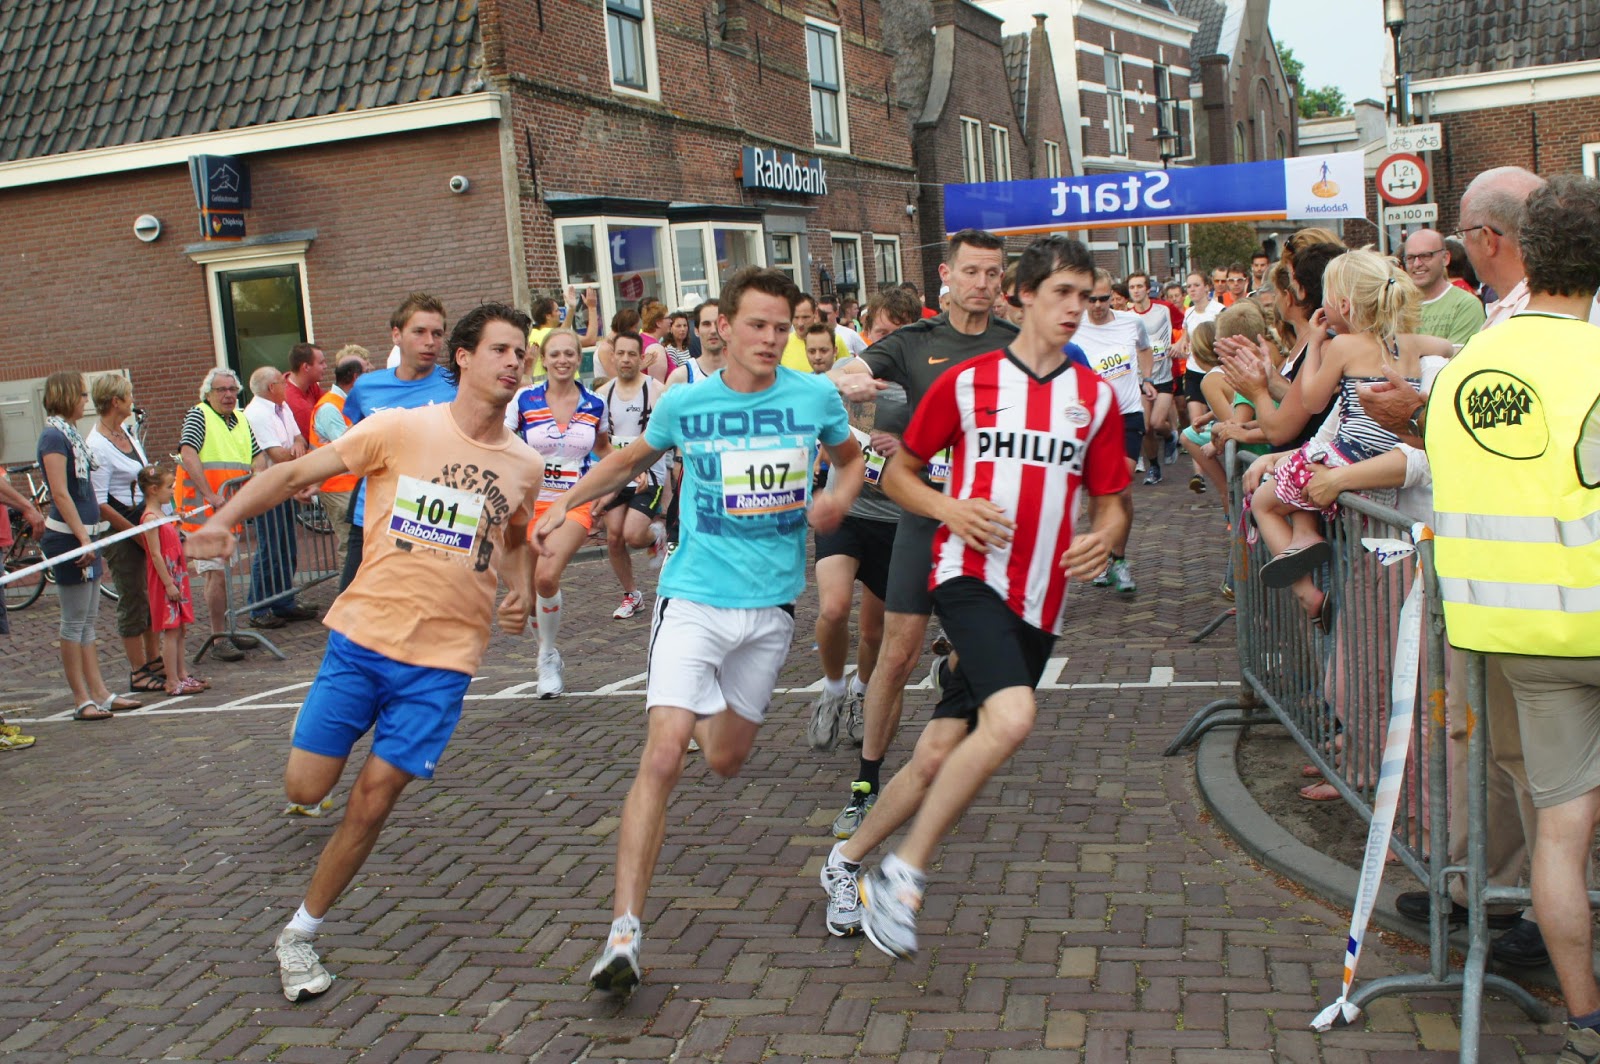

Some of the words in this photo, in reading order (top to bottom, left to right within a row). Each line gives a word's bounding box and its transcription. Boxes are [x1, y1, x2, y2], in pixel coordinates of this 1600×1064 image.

[754, 147, 828, 195] Rabobank
[1389, 212, 1400, 220] na
[1403, 209, 1422, 219] 100
[1424, 210, 1434, 218] m
[1100, 354, 1122, 370] 300
[1470, 388, 1526, 407] SPORT
[1474, 408, 1517, 424] DORP
[542, 481, 571, 490] bobank
[745, 463, 790, 491] 107
[736, 491, 796, 508] Rabobank
[416, 495, 459, 529] 101
[400, 520, 462, 546] Rabobank
